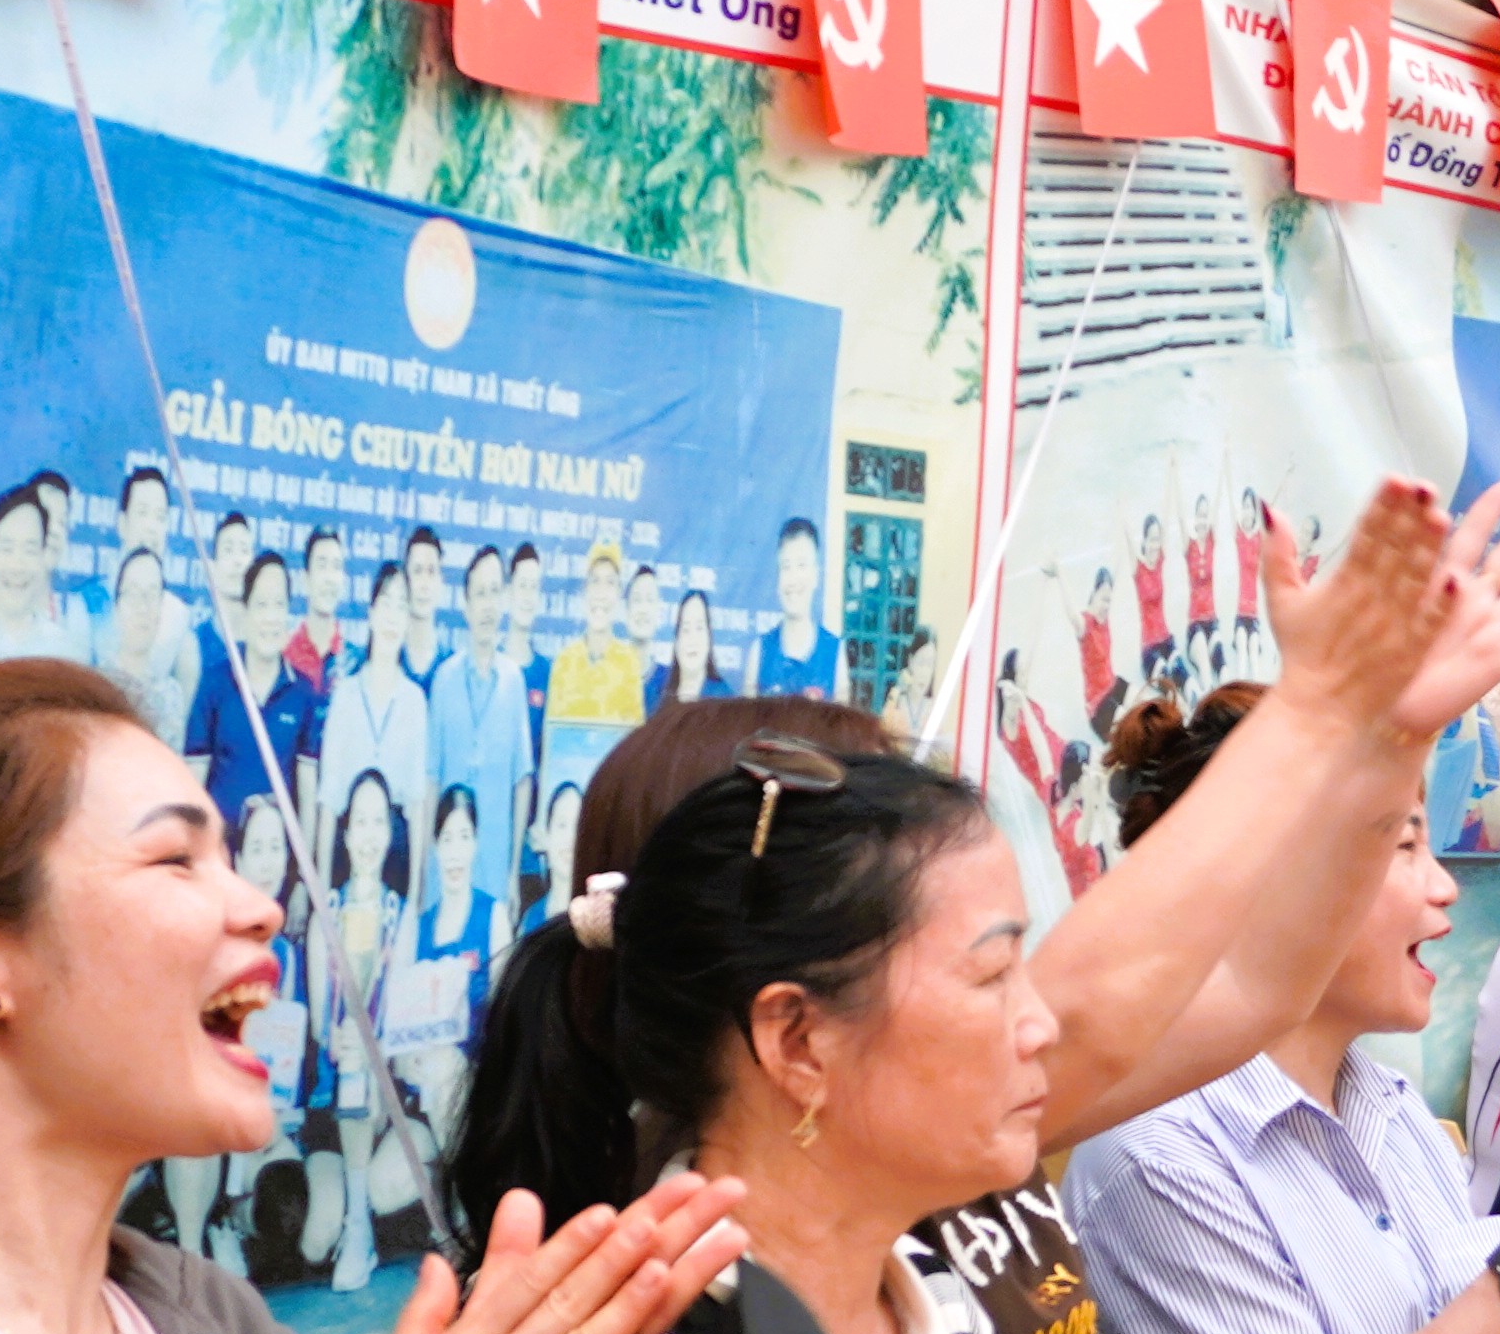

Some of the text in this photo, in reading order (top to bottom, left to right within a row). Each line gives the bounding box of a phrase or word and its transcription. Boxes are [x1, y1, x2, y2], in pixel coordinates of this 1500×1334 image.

[1409, 140, 1485, 188] Đồng
[164, 378, 246, 446] GIẢI
[250, 397, 345, 461] BÓNG
[536, 451, 598, 498] NAM
[602, 452, 646, 502] NỮ
